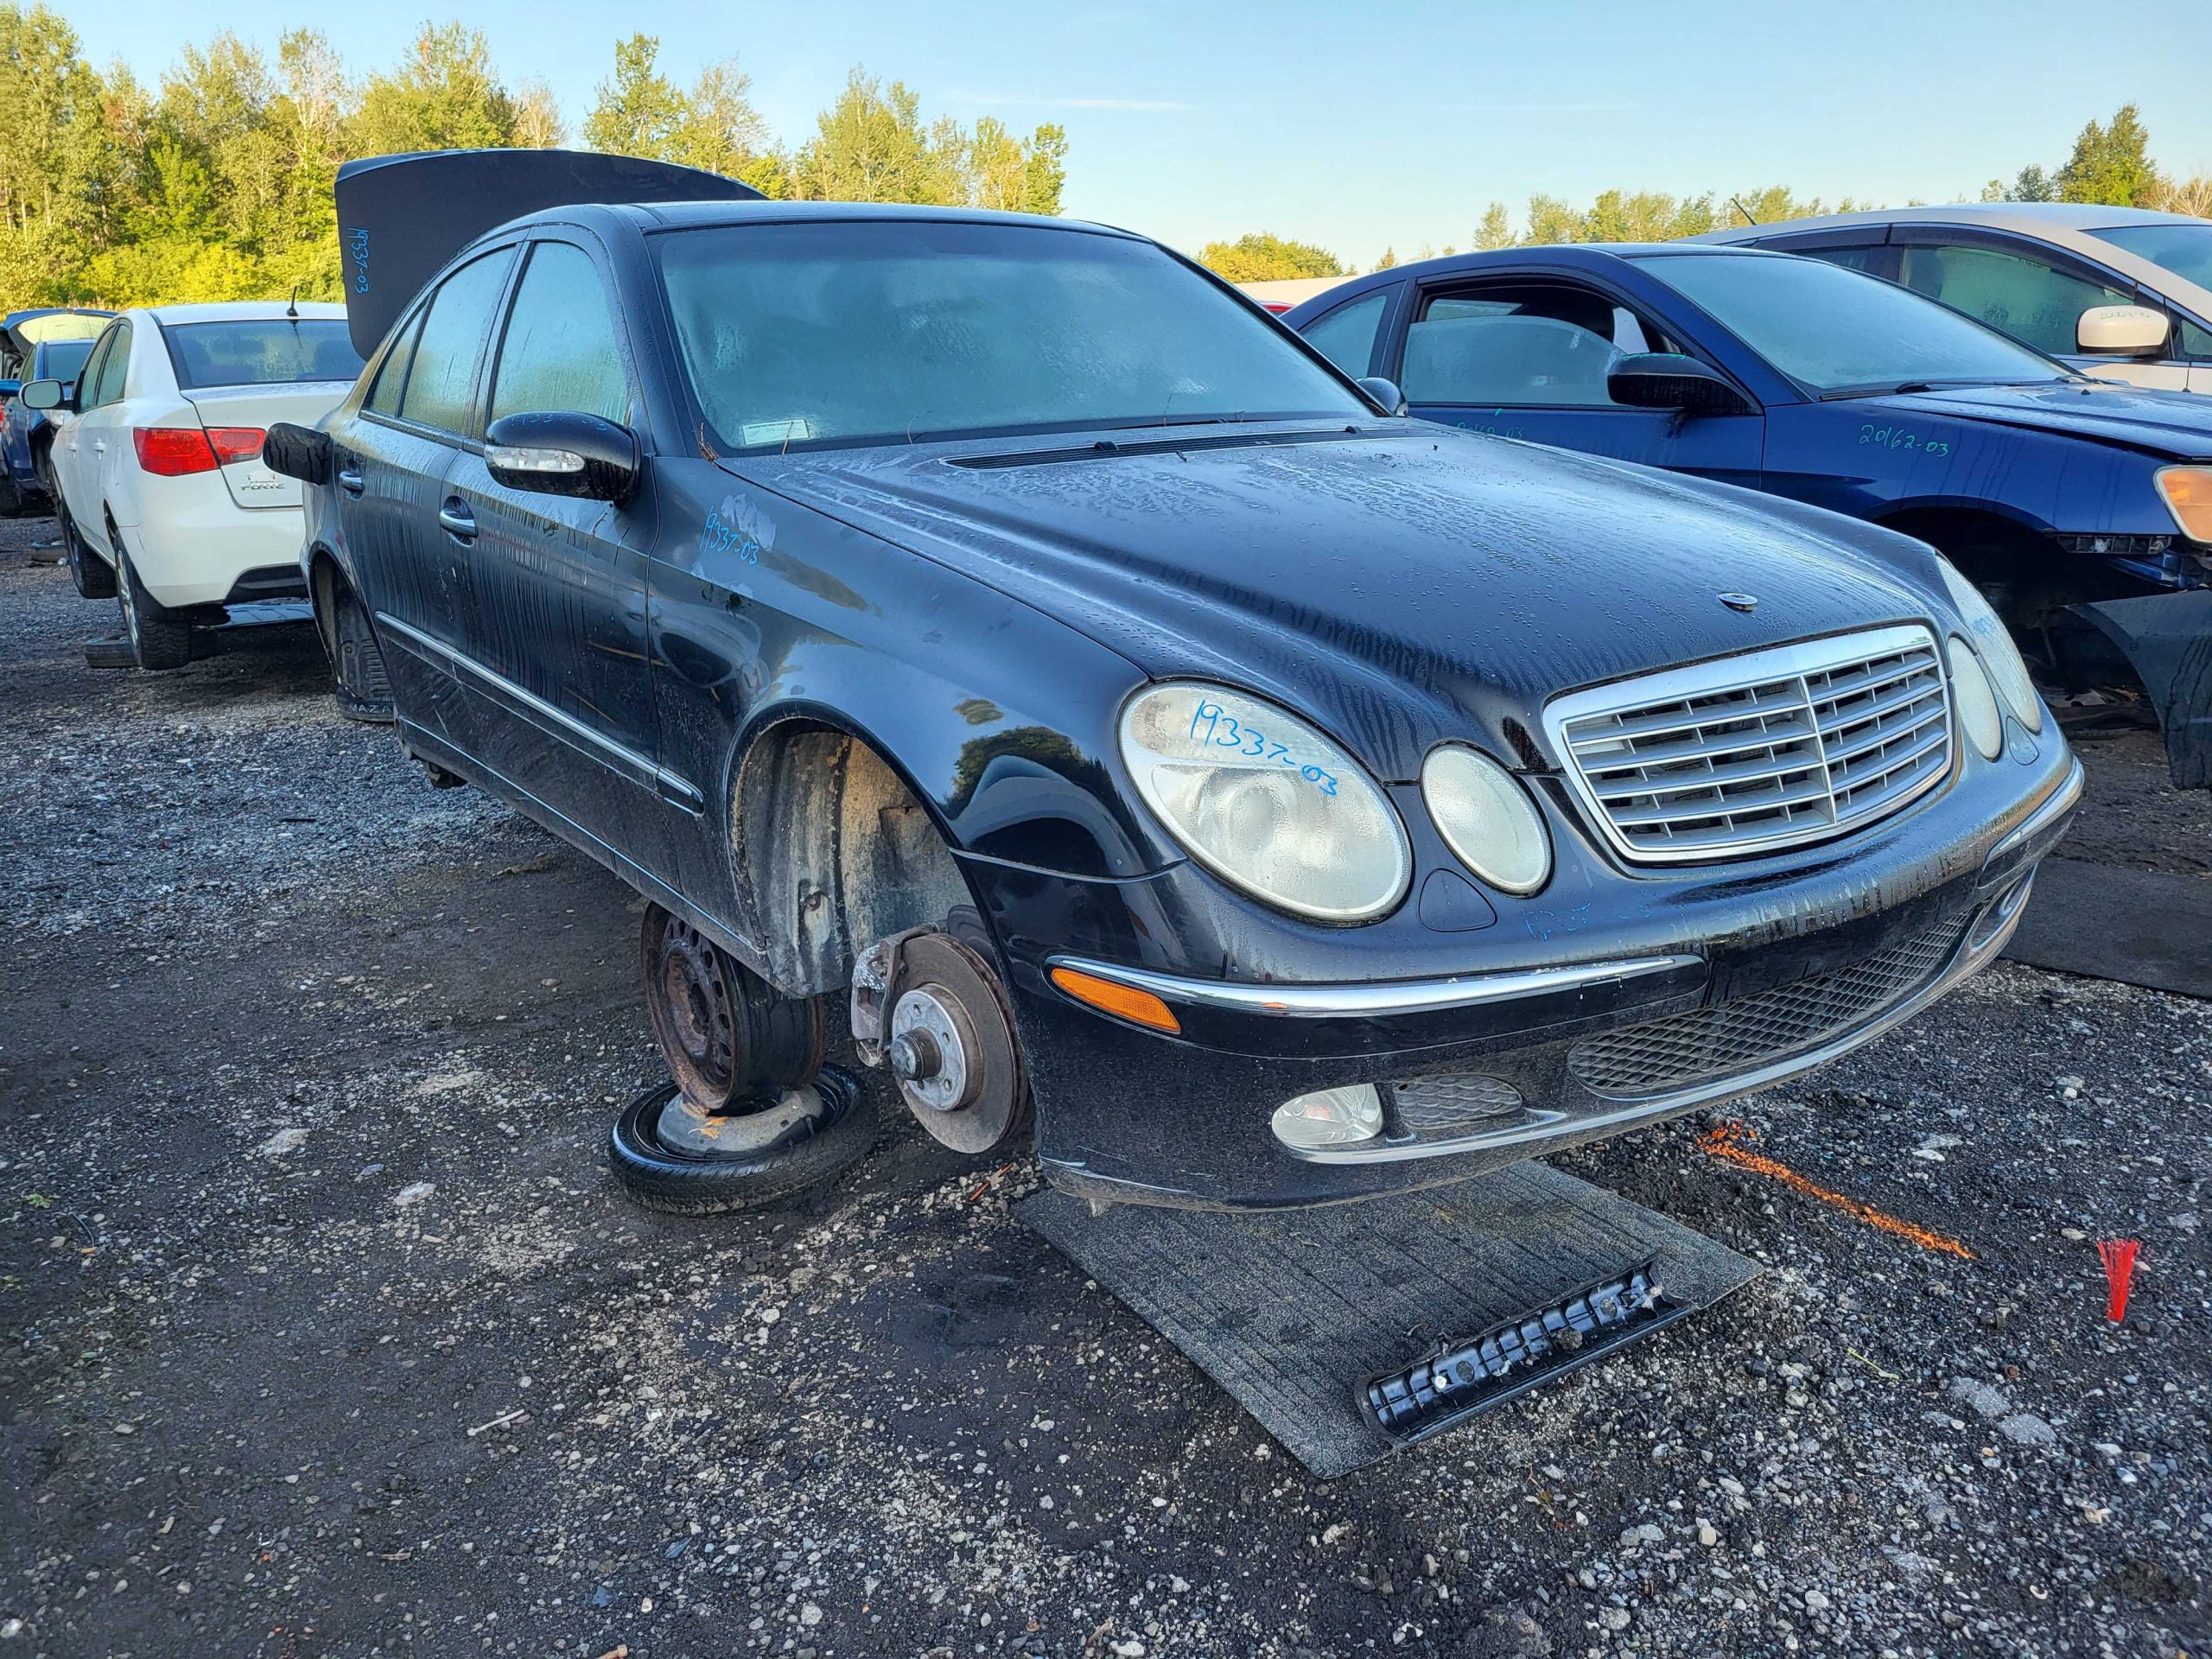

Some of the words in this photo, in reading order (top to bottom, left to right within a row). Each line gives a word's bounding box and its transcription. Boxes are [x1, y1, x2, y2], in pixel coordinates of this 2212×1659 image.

[1859, 424, 1948, 457] 20162-03
[698, 505, 760, 565] 19337-03
[1190, 699, 1338, 797] 19337-03
